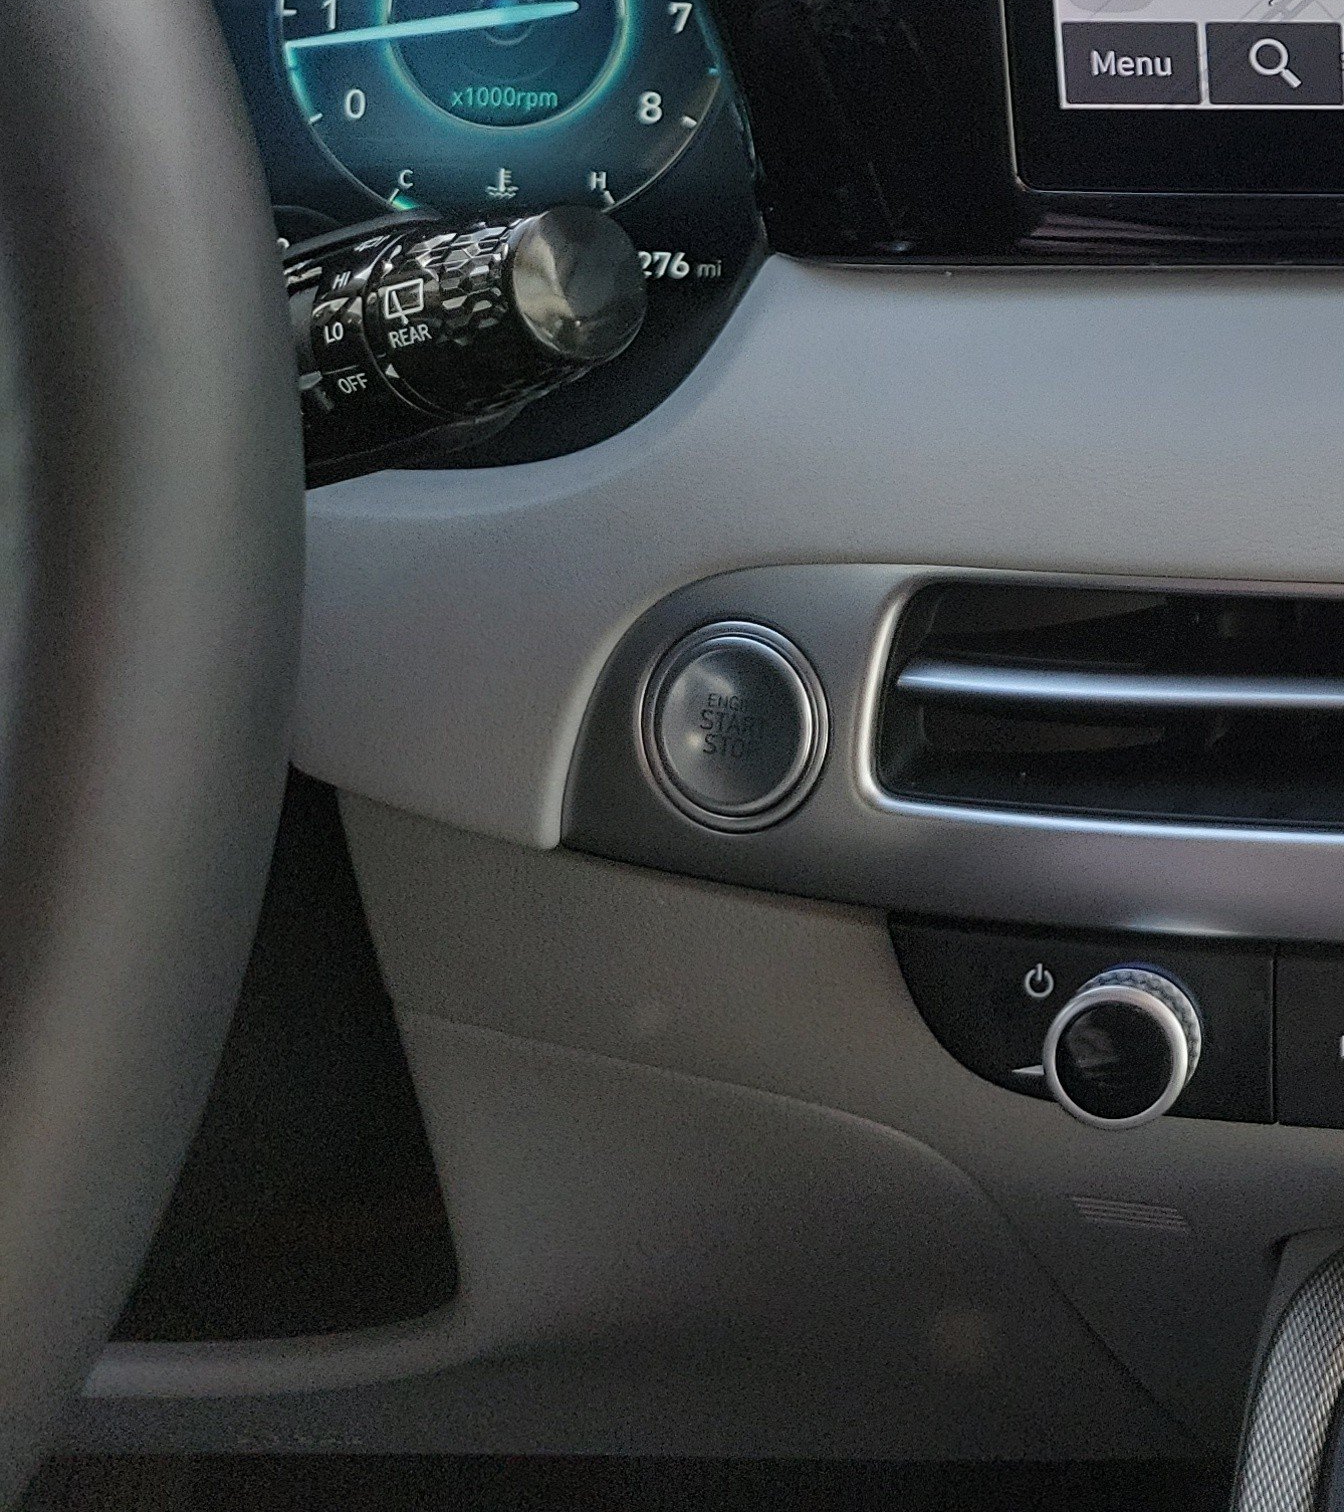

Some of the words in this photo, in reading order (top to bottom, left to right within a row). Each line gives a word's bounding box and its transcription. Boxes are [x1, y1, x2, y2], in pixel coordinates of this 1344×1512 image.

[668, 1, 694, 33] 7
[1090, 50, 1172, 77] Menu
[344, 88, 367, 120] 0
[451, 86, 559, 109] x1000rpm
[638, 93, 664, 123] 8
[398, 168, 414, 189] C
[589, 170, 607, 190] H
[638, 251, 690, 280] 276
[697, 260, 722, 278] mi
[324, 321, 344, 344] LO
[388, 324, 432, 349] REAR
[337, 372, 368, 394] OFF
